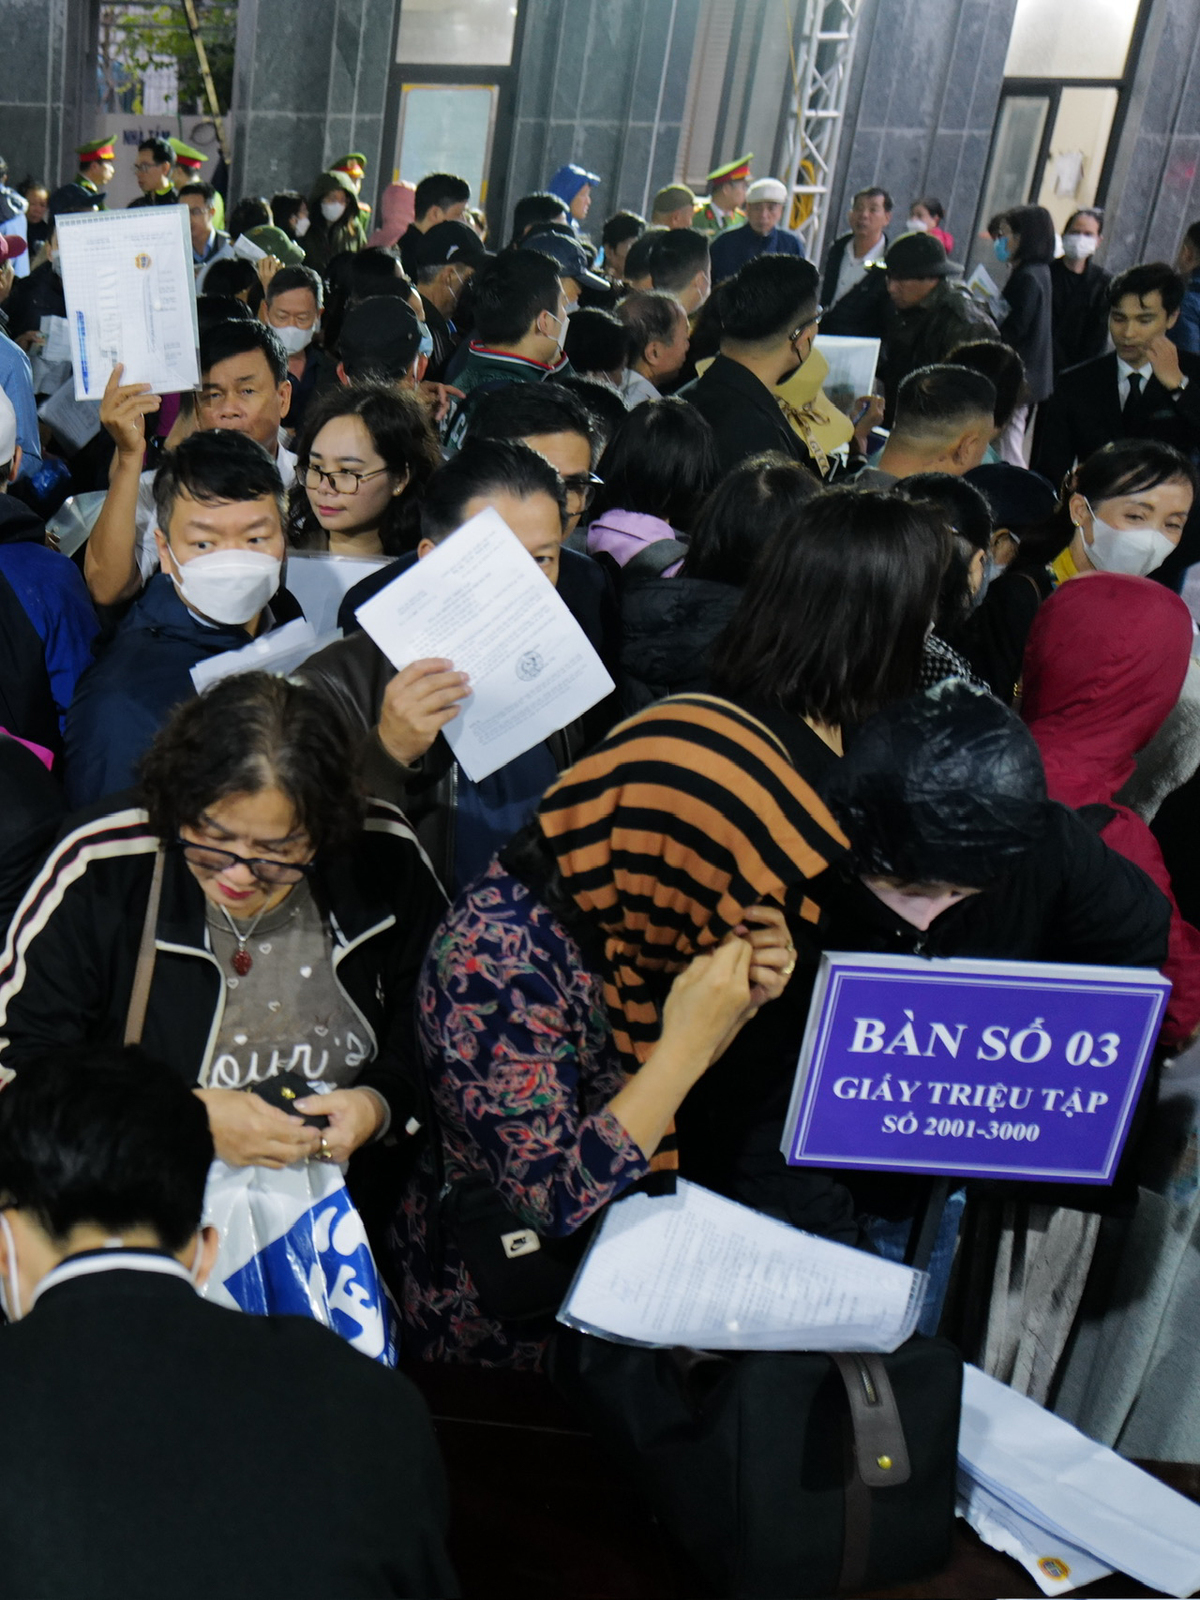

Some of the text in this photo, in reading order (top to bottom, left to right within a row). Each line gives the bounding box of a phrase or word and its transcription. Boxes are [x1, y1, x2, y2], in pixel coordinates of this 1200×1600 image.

[846, 1008, 1122, 1069] BÀN SỐ 03
[831, 1072, 1110, 1118] GIẤY TRIỆU TẬP
[880, 1110, 1041, 1143] SỐ 2001-3000
